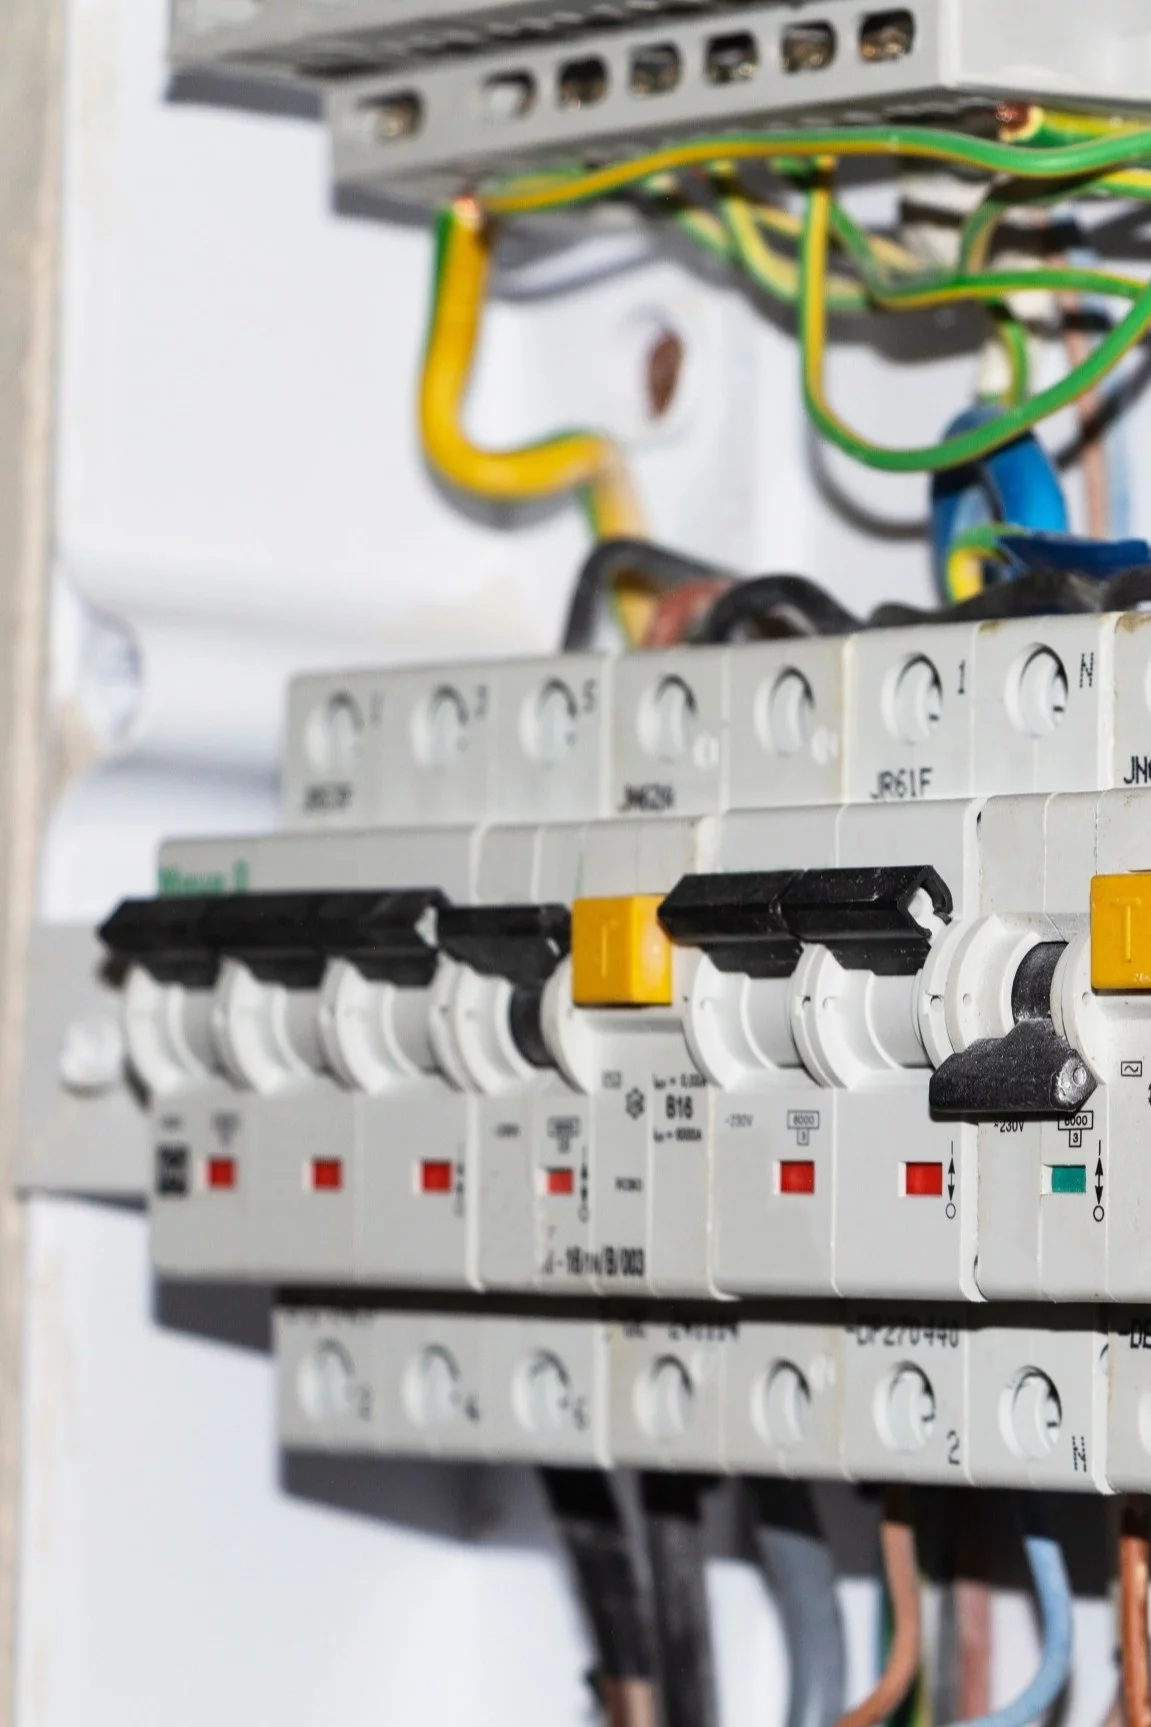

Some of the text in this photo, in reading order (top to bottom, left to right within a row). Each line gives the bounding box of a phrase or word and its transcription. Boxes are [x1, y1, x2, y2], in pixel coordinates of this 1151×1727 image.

[1079, 652, 1094, 688] N
[945, 1429, 961, 1466] 2
[1071, 1435, 1088, 1473] N
